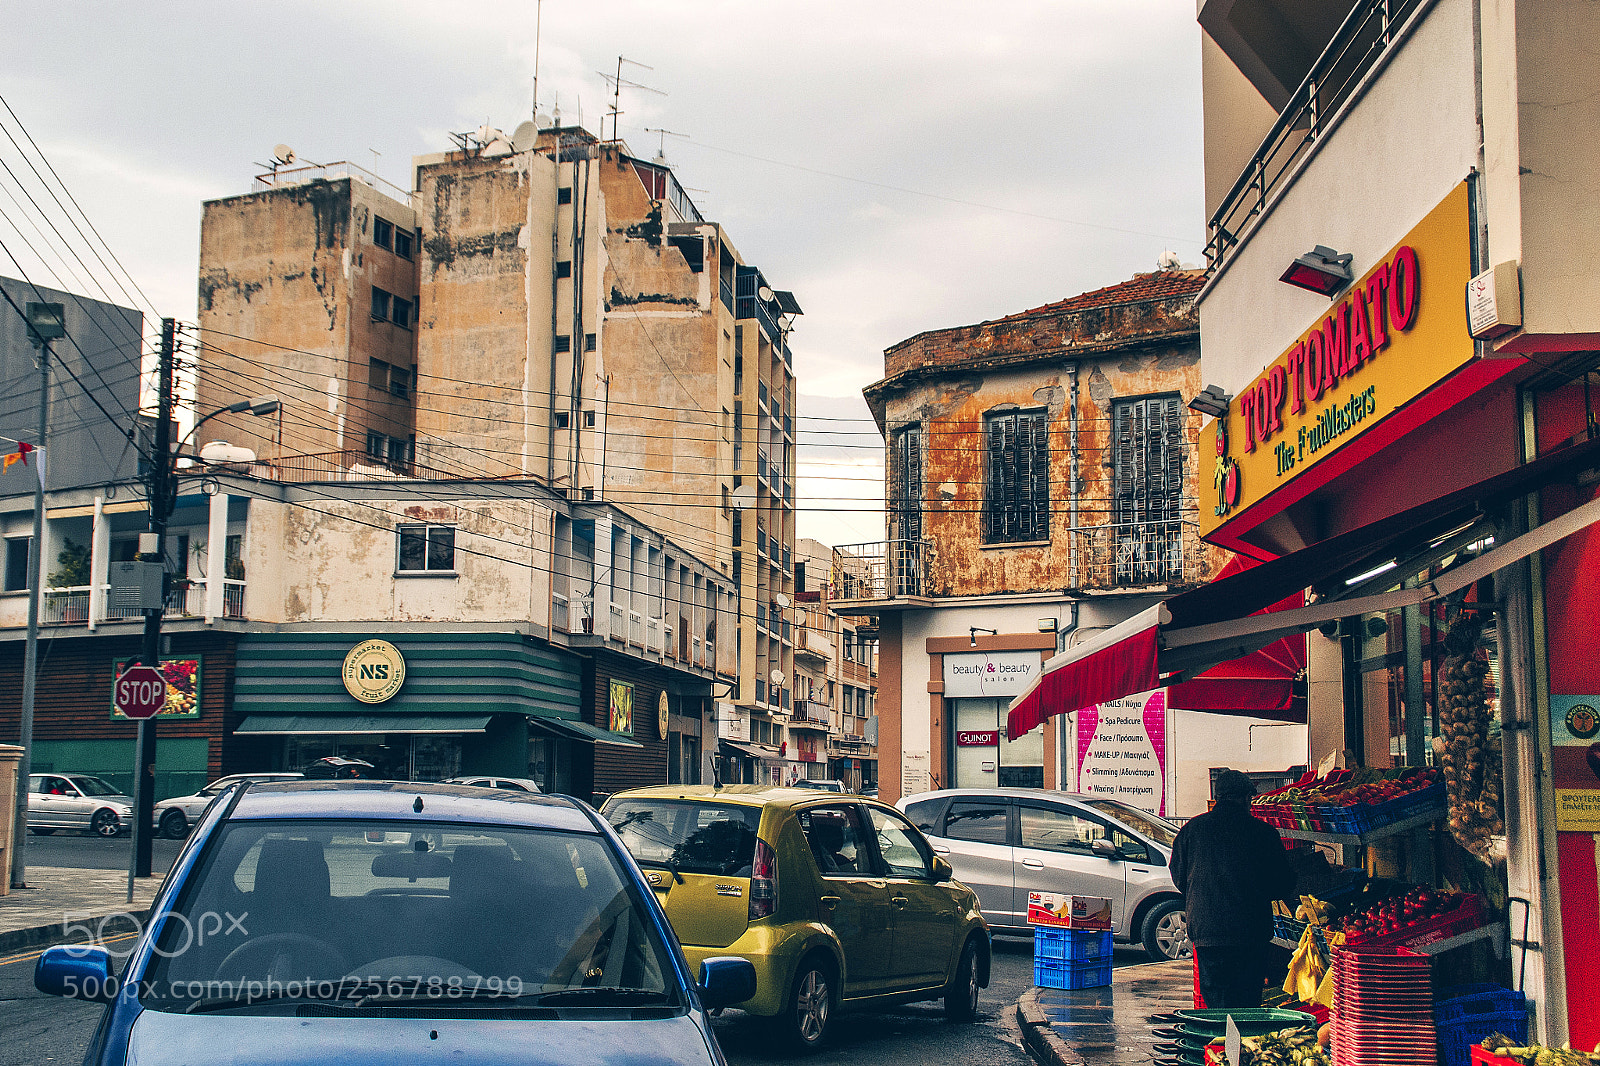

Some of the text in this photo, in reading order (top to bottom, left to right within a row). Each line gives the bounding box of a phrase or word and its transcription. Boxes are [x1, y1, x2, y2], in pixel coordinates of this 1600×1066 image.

[1240, 245, 1417, 453] TOP TOMATO
[1274, 441, 1295, 476] The
[348, 644, 385, 678] supermarket
[360, 664, 388, 679] NS
[953, 663, 1031, 676] beauty & beauty
[361, 669, 400, 698] fruit market
[120, 681, 161, 705] STOP
[1105, 717, 1115, 726] Spa
[960, 732, 992, 742] GUINOT
[1092, 768, 1118, 777] Slimming
[1094, 785, 1114, 794] Waxing
[1072, 900, 1087, 909] Dole
